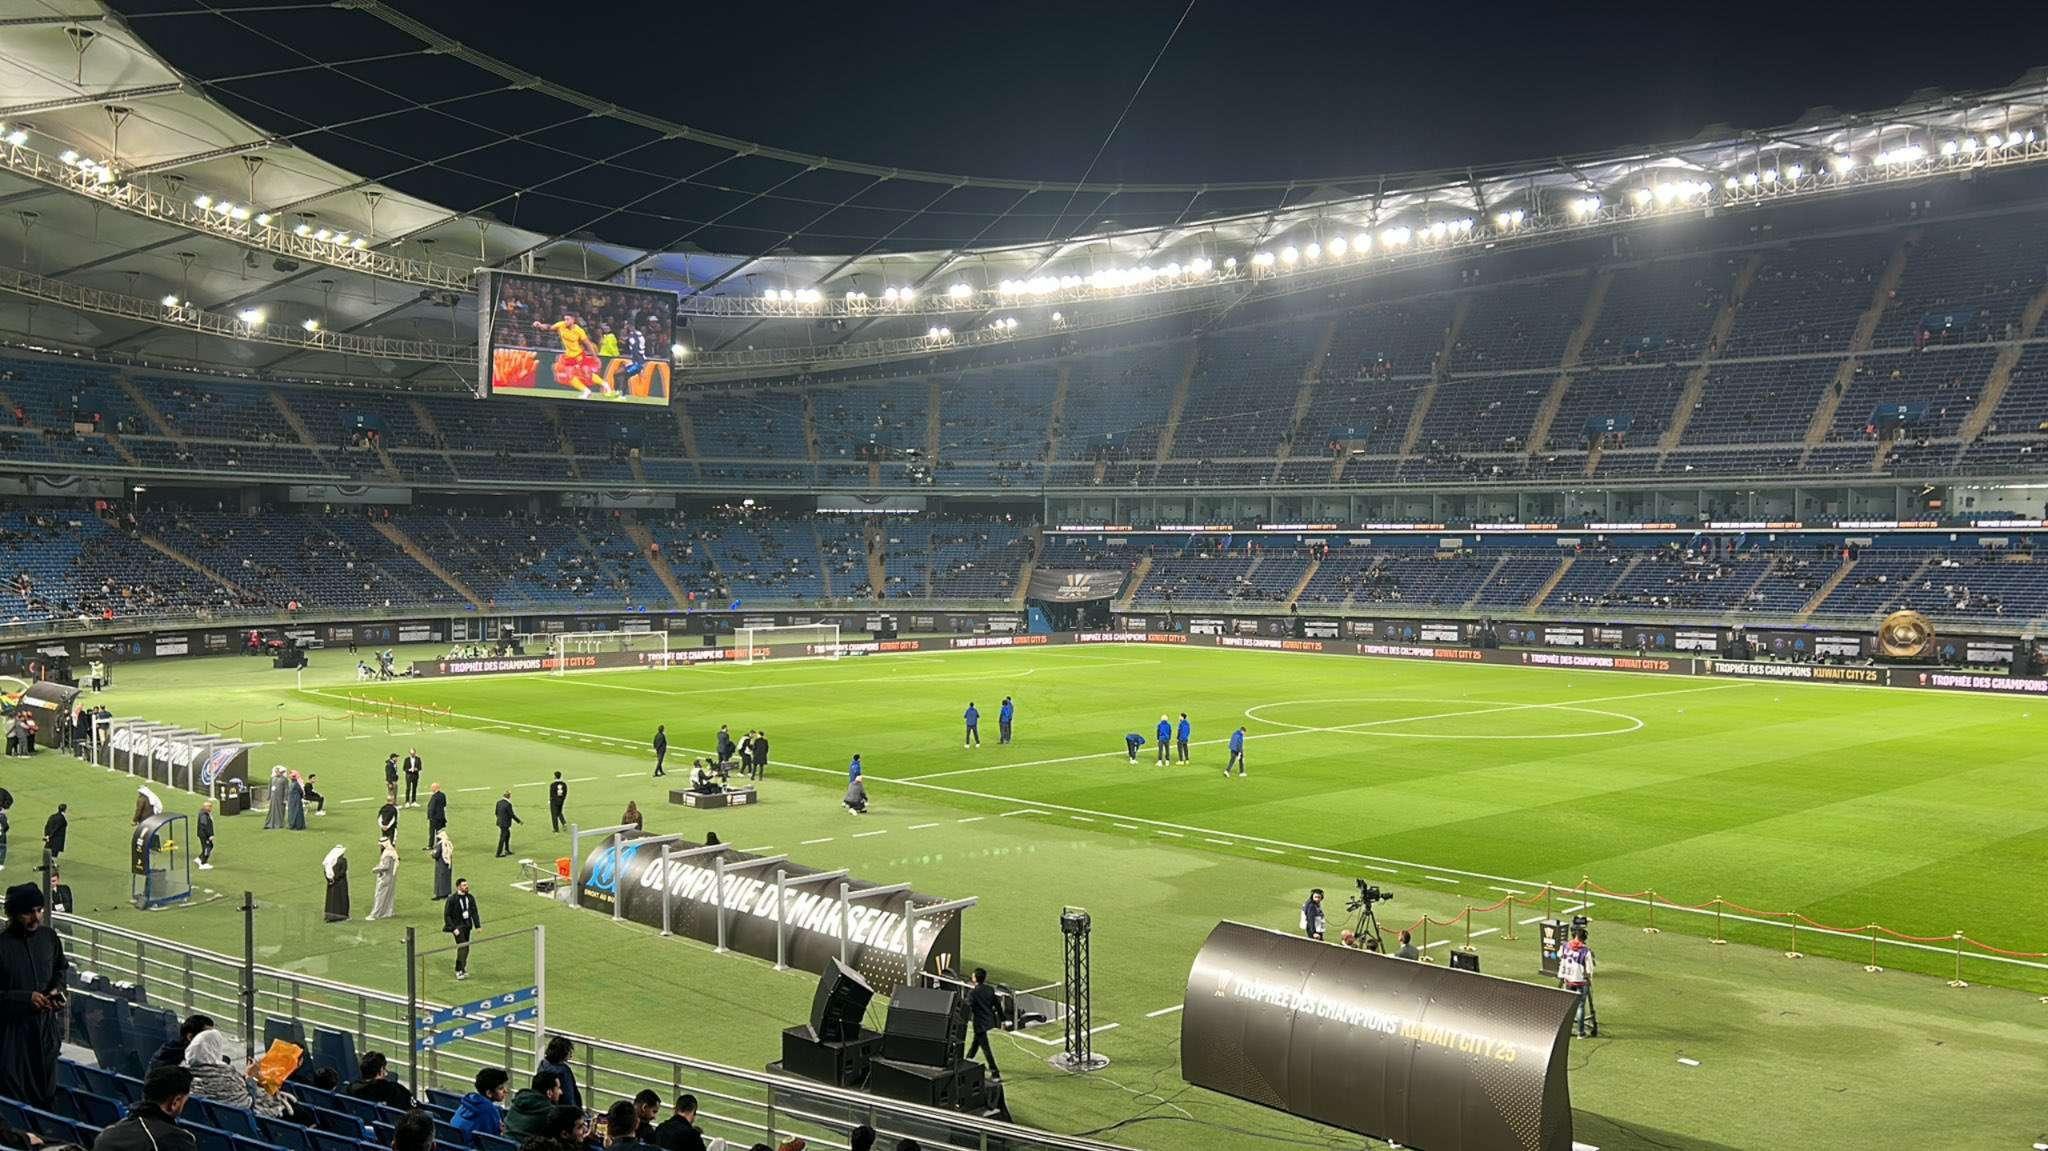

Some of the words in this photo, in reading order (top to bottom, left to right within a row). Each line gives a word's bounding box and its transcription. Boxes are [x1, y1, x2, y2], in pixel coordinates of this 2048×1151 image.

[484, 660, 499, 672] DES
[499, 659, 541, 671] CHAMPIONS
[586, 656, 596, 666] 25
[1560, 655, 1573, 665] DES
[1574, 656, 1613, 668] CHAMPIONS
[1614, 658, 1642, 669] KUWAIT
[1643, 659, 1659, 670] CITY
[1659, 660, 1670, 671] 25
[1715, 661, 1748, 674] TROPHÉE
[1749, 664, 1764, 675] DES
[1765, 664, 1812, 678] CHAMPIONS
[1813, 668, 1844, 679] KUWAIT
[1845, 669, 1865, 680] CITY
[1865, 670, 1877, 681] 25
[1932, 674, 1972, 688] TROPHÉE
[1973, 677, 1991, 689] DES
[1992, 678, 2048, 692] CHAMPIONS
[1233, 980, 1291, 1008] TROPHÉE
[1291, 993, 1315, 1015] DES
[1316, 996, 1398, 1034] CHAMPIONS
[1400, 1020, 1456, 1049] KUWAIT
[1459, 1033, 1494, 1058] CITY
[1494, 1038, 1517, 1062] 25
